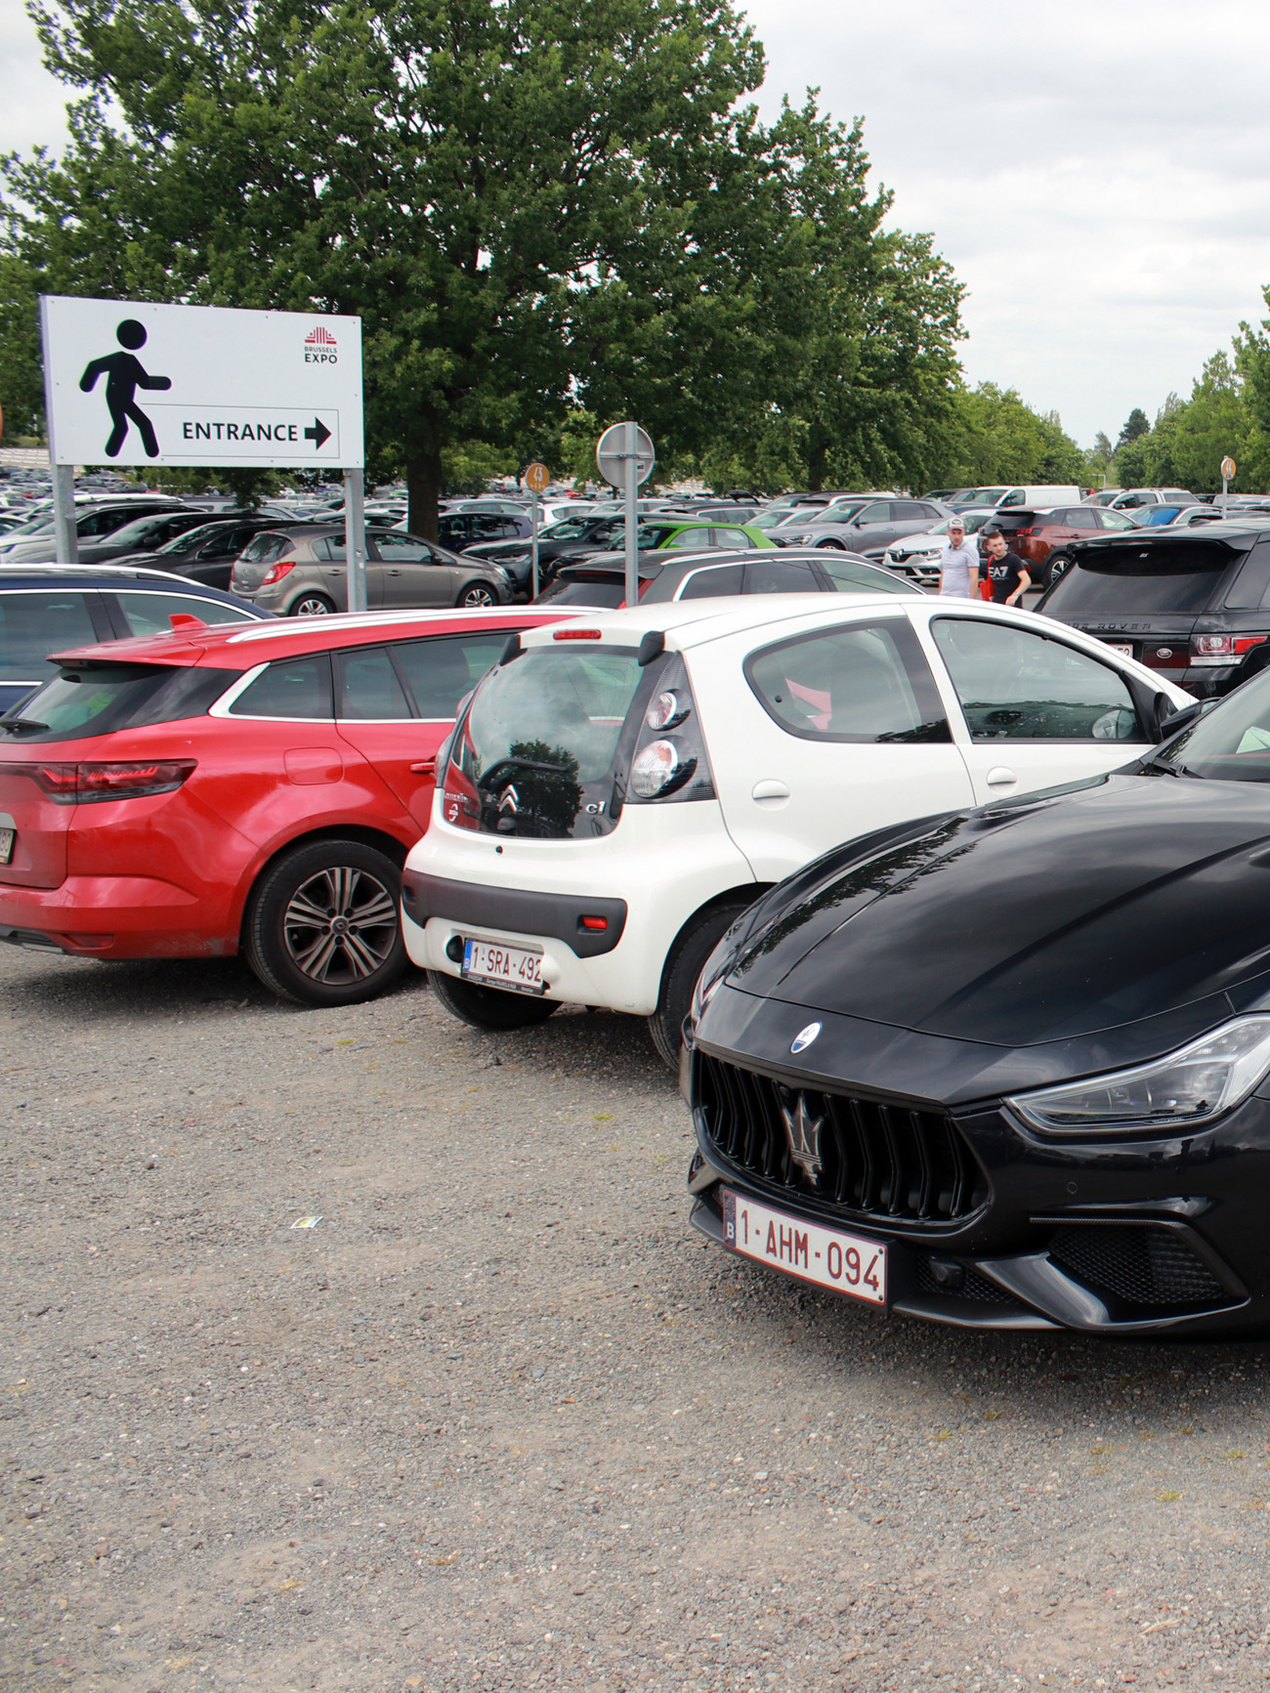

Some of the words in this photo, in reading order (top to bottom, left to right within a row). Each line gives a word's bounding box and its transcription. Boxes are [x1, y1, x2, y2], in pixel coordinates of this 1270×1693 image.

[304, 346, 338, 354] BRUSSELS
[304, 353, 338, 364] EXPO
[182, 421, 299, 442] ENTRANCE
[1097, 622, 1152, 631] ROVER
[464, 958, 470, 969] B
[726, 1221, 735, 1240] B
[741, 1209, 879, 1292] 1-AHM-094
